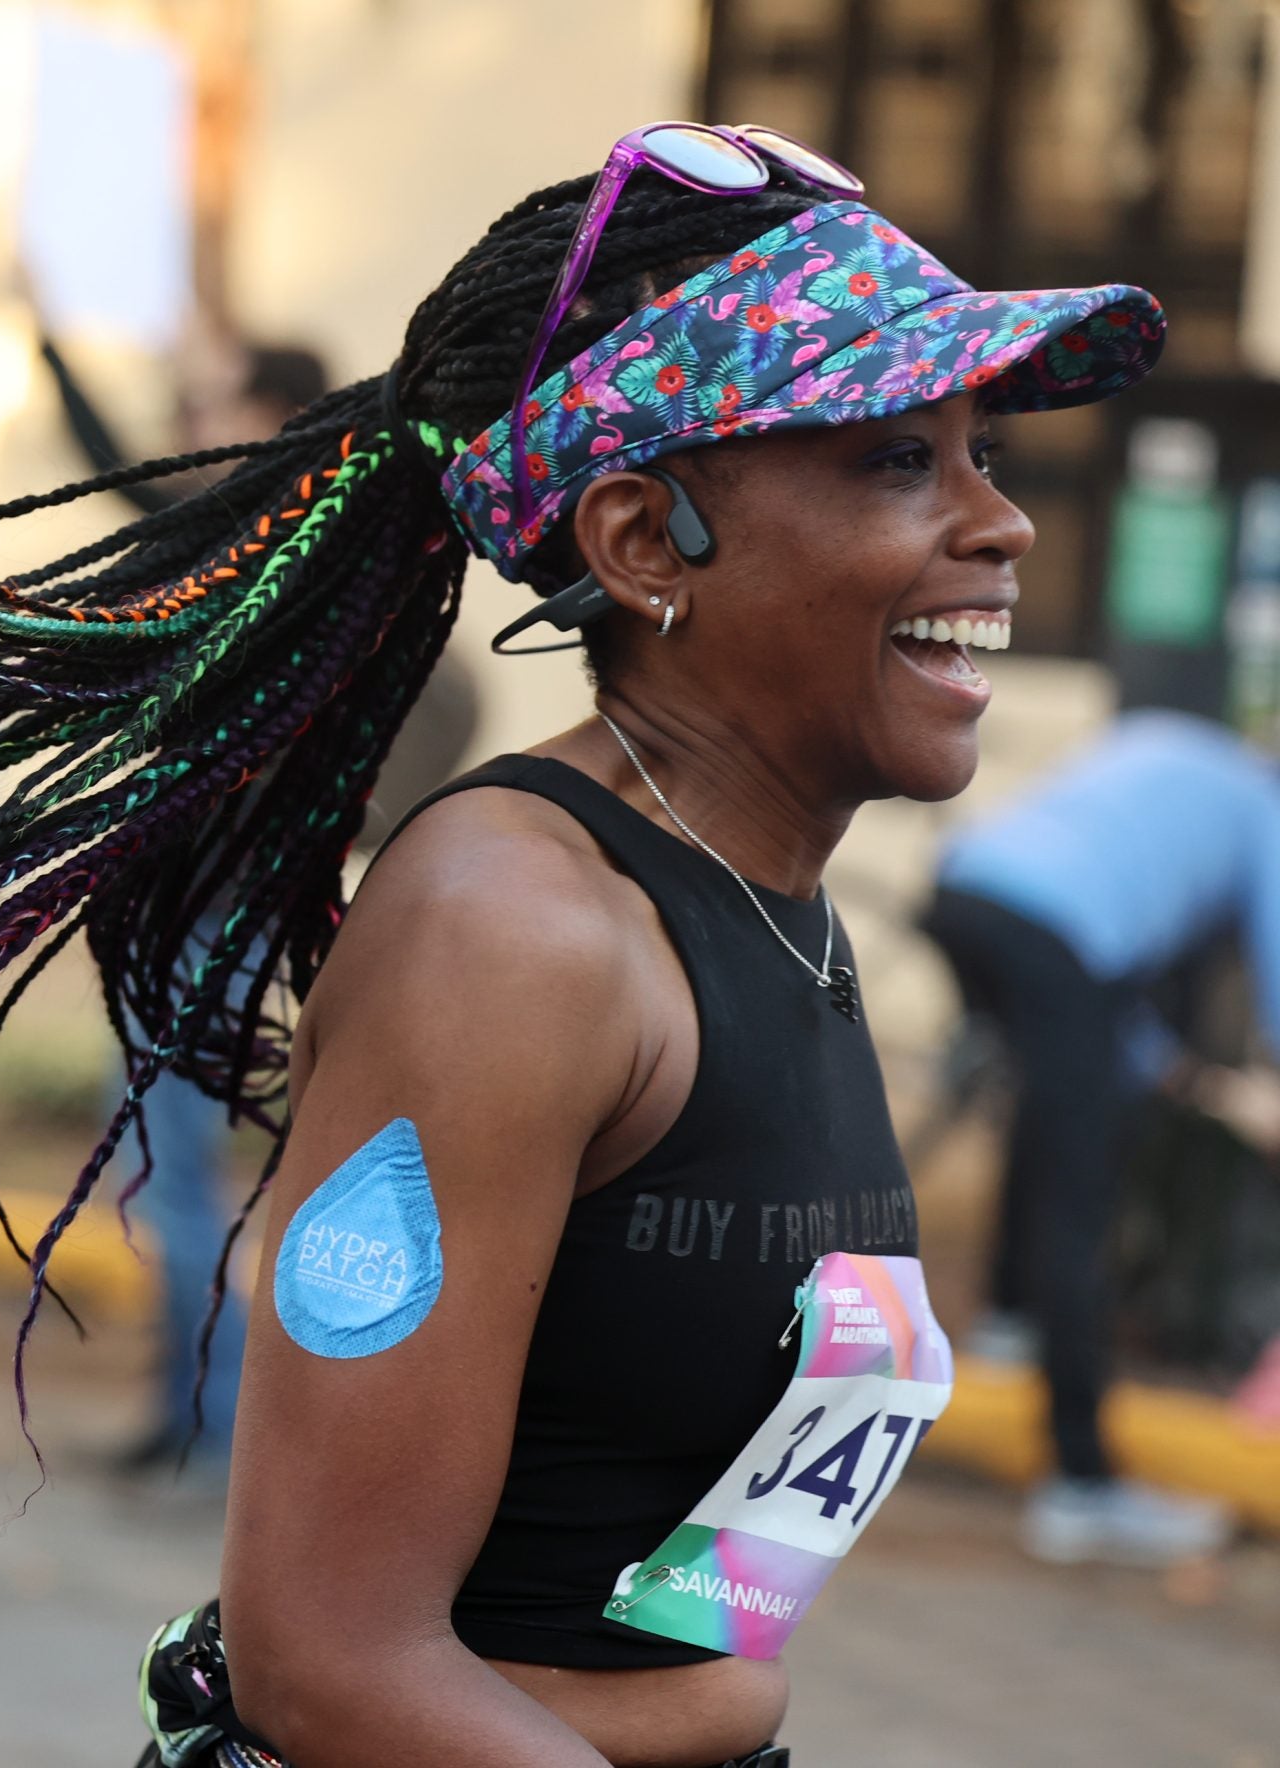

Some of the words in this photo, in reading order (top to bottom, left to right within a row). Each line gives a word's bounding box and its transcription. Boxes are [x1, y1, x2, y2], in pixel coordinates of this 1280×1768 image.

[304, 1222, 408, 1272] HYDRA
[625, 1193, 736, 1261] BUY
[759, 1197, 835, 1264] FROM
[298, 1244, 407, 1295] PATCH
[670, 1566, 798, 1620] SAVANNAH
